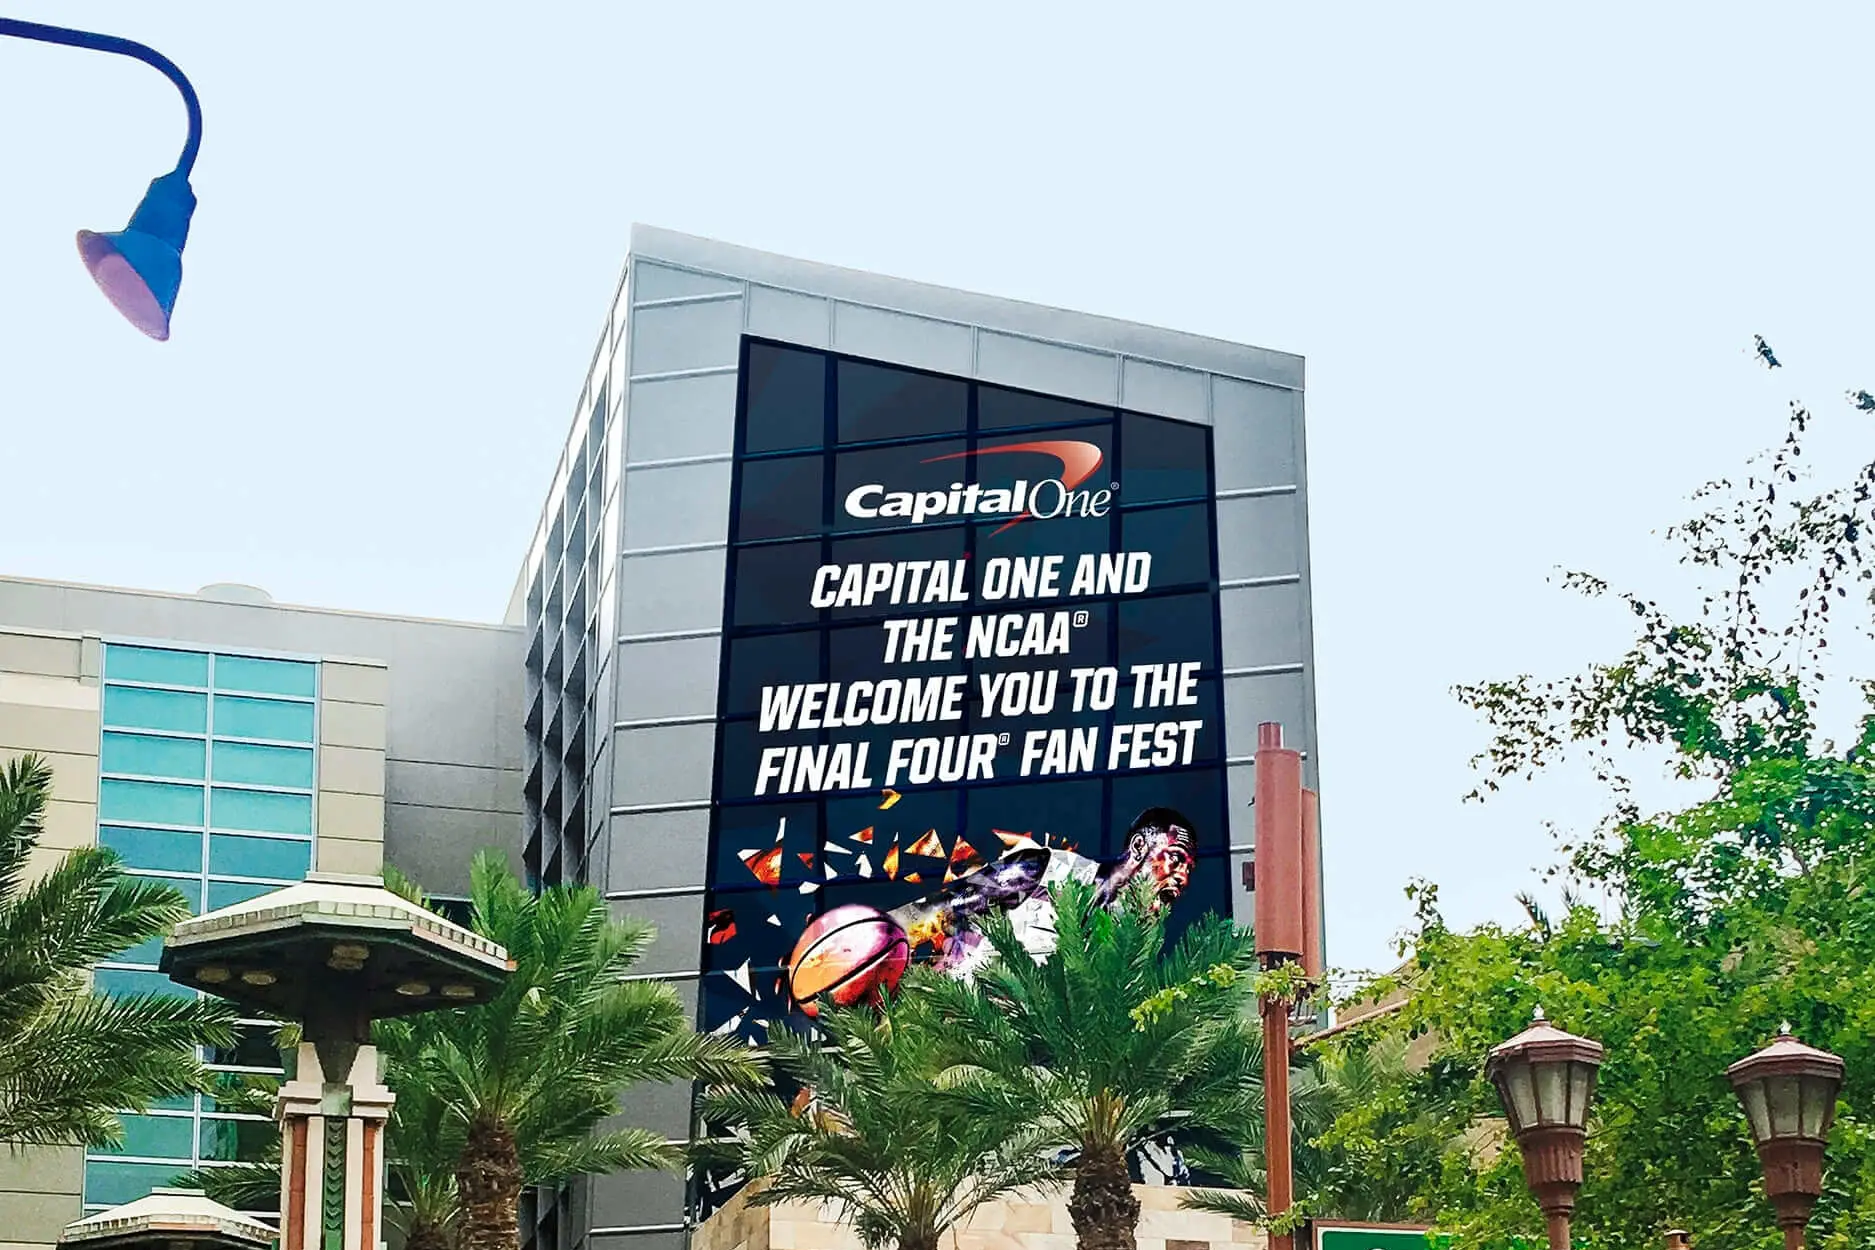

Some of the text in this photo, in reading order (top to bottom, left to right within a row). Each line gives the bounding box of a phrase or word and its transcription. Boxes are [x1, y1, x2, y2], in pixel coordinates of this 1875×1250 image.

[810, 551, 1152, 608] CAPITAL ONE AND
[883, 617, 958, 663] THE
[759, 662, 1201, 732] WELCOME YOU TO THE
[754, 742, 872, 796] FINAL
[1020, 727, 1099, 777] FAN
[1107, 720, 1203, 771] FEST
